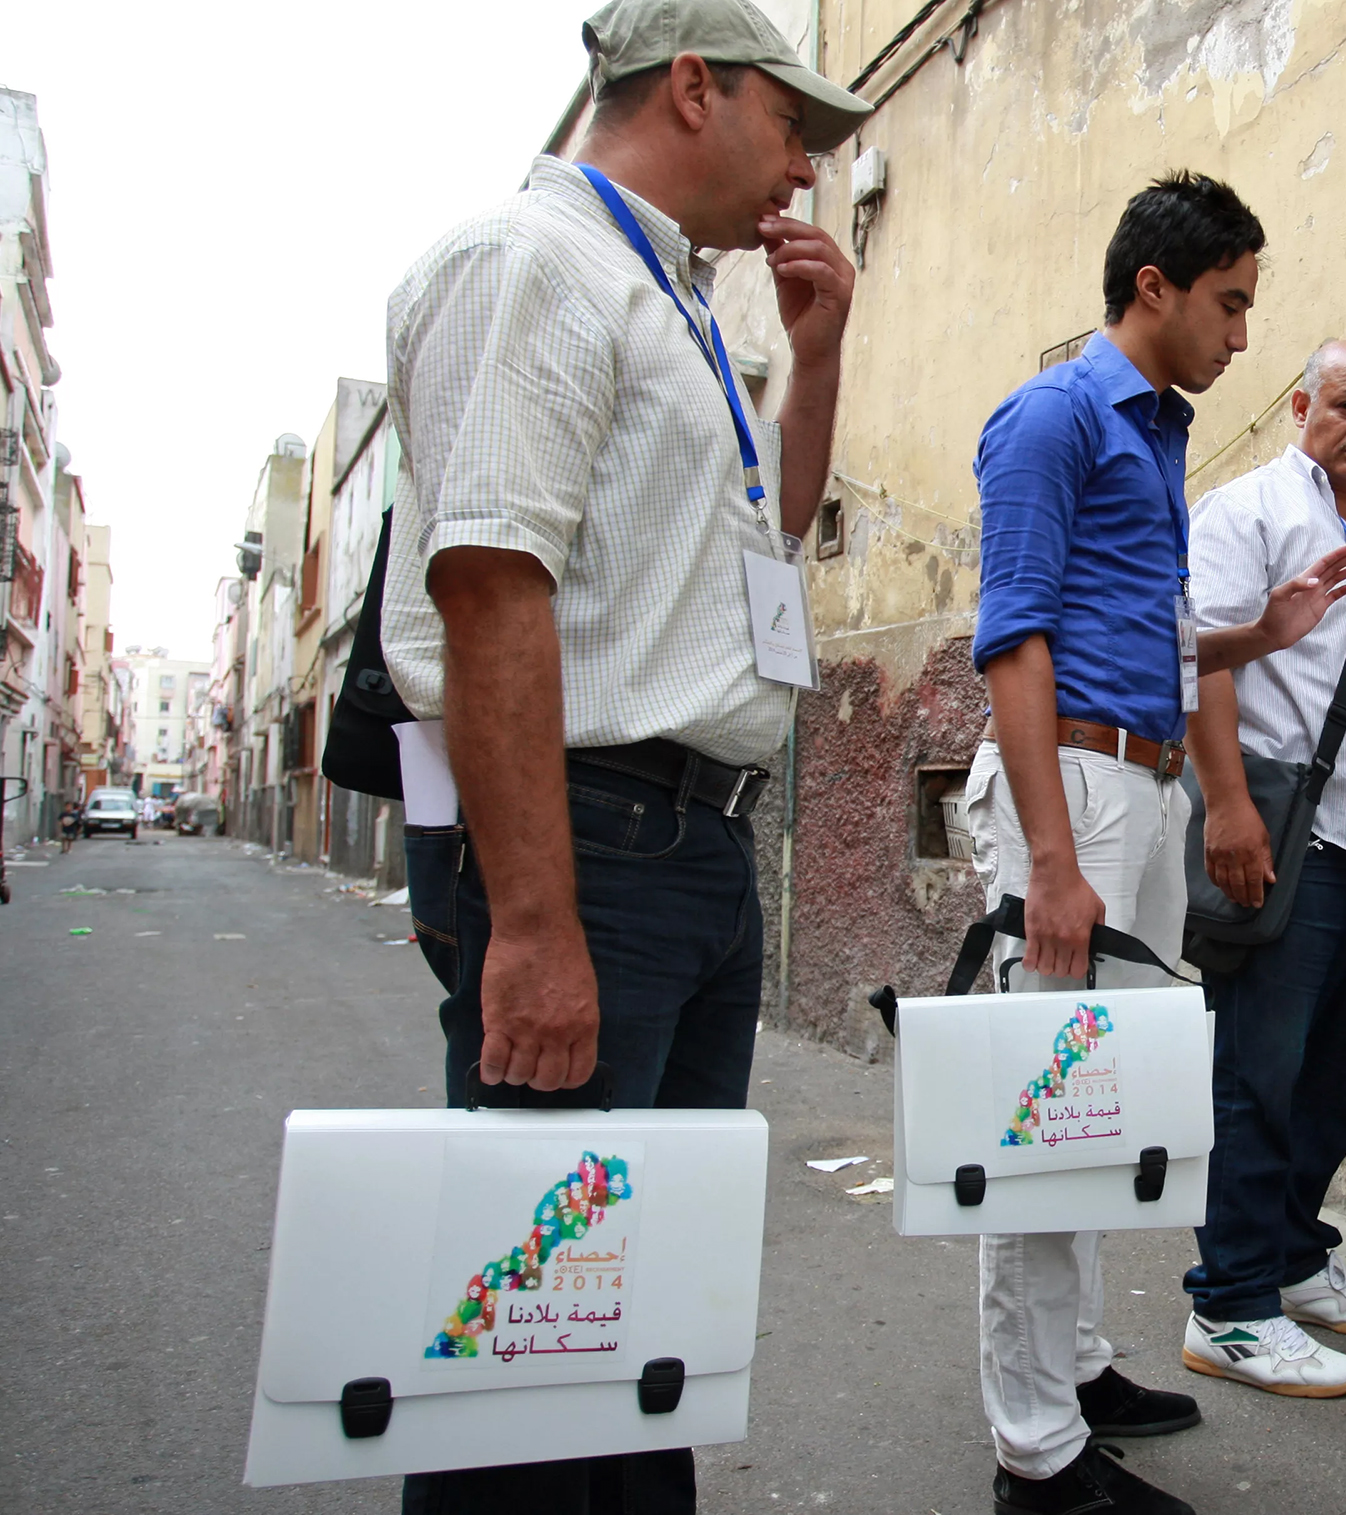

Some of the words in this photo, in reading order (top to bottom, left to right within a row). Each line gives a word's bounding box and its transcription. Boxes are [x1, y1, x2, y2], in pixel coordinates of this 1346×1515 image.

[1071, 1057, 1116, 1079] إحصاء
[1073, 1083, 1118, 1098] 2014
[1047, 1105, 1081, 1122] بلادنا
[1086, 1101, 1121, 1120] قيمة
[1041, 1125, 1122, 1147] سكانها
[555, 1236, 627, 1265] إحصاء
[552, 1274, 623, 1291] 2014
[508, 1302, 560, 1329] بلادنا
[567, 1301, 622, 1328] قيمة
[492, 1333, 618, 1363] سكانها
